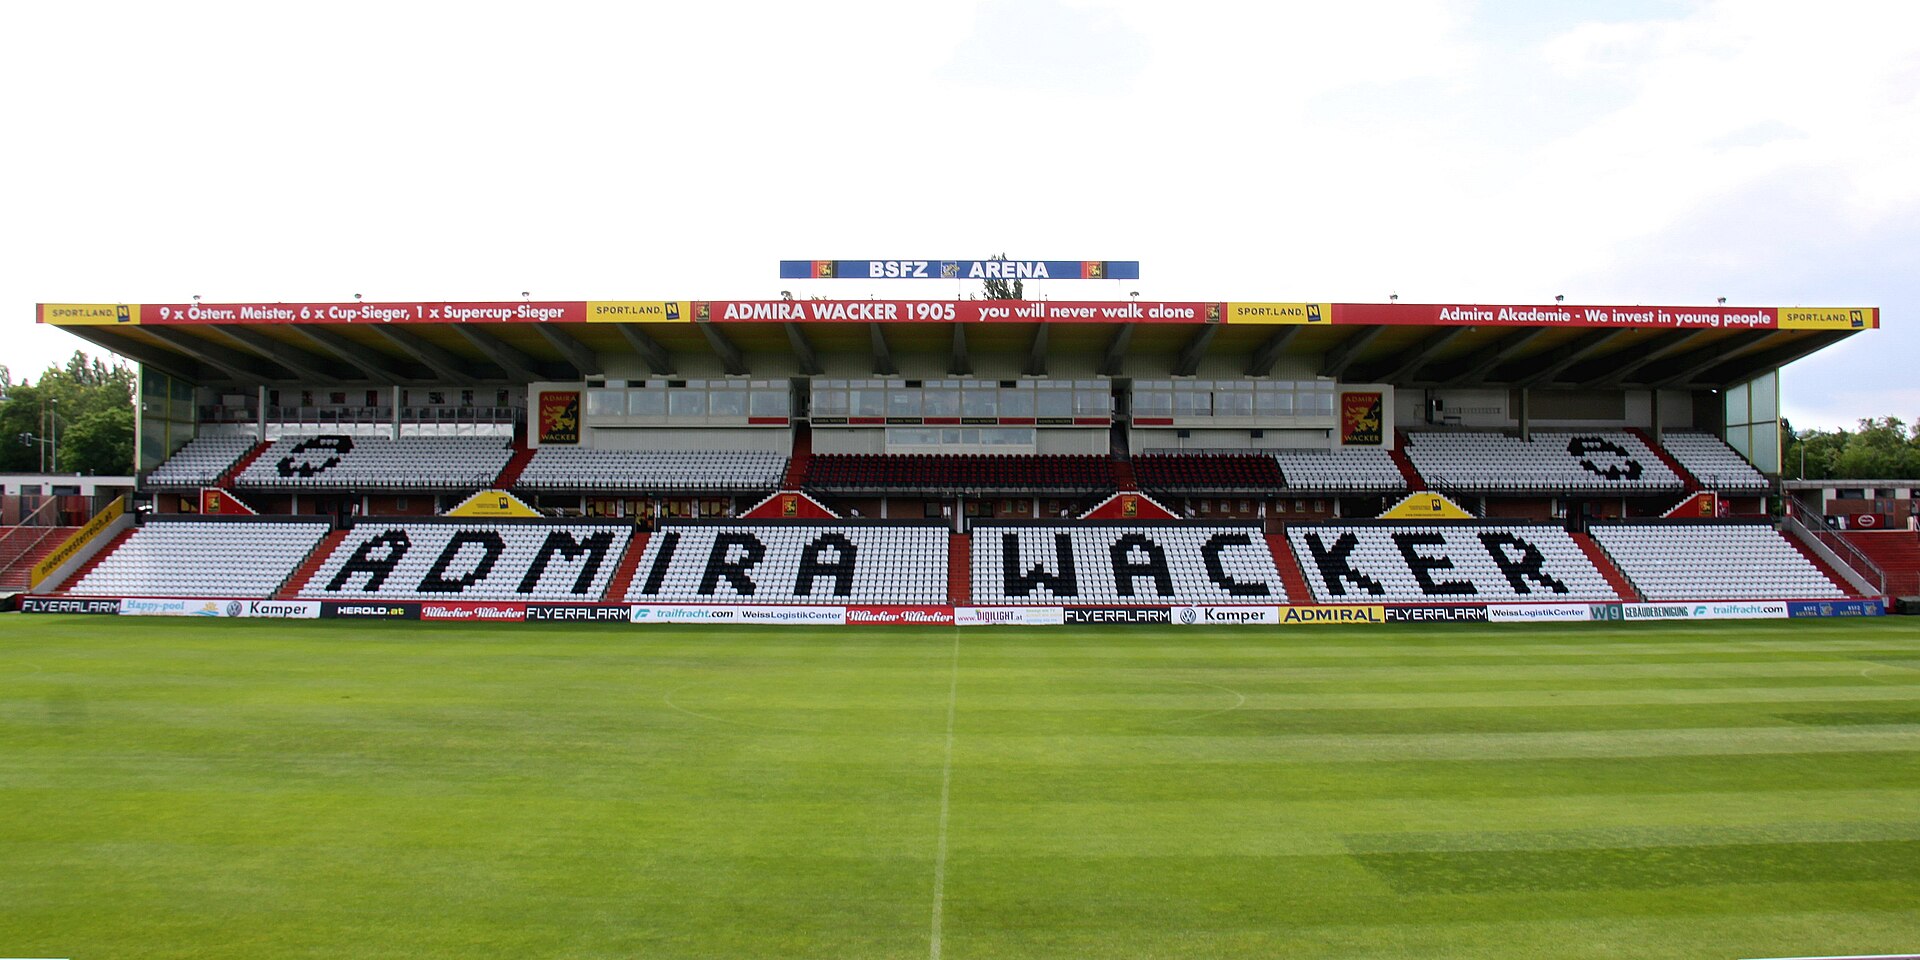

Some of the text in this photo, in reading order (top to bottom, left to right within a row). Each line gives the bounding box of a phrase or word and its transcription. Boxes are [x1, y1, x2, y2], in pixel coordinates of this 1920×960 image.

[869, 262, 1050, 278] BSFZ ARENA
[52, 308, 114, 317] SPORT.LAND.
[159, 303, 564, 321] 9 x Österr. Meister, 6 x Cup-Sieger, 1 x Supercup-Sieger
[596, 306, 663, 315] SPORT.LAND.
[723, 303, 956, 320] ADMIRA WACKER 1905
[978, 302, 1195, 321] you will never walk alone
[1237, 307, 1304, 316] SPORT.LAND.
[1439, 307, 1493, 321] Admira
[1498, 308, 1571, 322] Akademie
[1584, 310, 1608, 322] We
[1612, 309, 1654, 323] invest
[1658, 310, 1671, 323] in
[1676, 312, 1720, 327] young
[1723, 310, 1771, 327] people
[1787, 313, 1848, 322] SPORT.LAND.
[22, 600, 120, 612] FLYERALARM
[127, 599, 185, 611] Happy-pool
[250, 601, 308, 617] Kamper
[337, 606, 404, 616] HEROLD.at
[1713, 604, 1783, 615] trailfracht.com
[526, 607, 630, 620] FLYERALARM
[656, 608, 734, 619] trailfracht.com
[742, 610, 842, 620] WeissLogistikCenter
[1064, 610, 1170, 622] FLYERALARM
[1204, 608, 1265, 623] Kamper
[1284, 607, 1381, 622] ADMIRAL
[1385, 608, 1487, 620] FLYERALARM
[1491, 609, 1584, 618] WeissLogistikCenter
